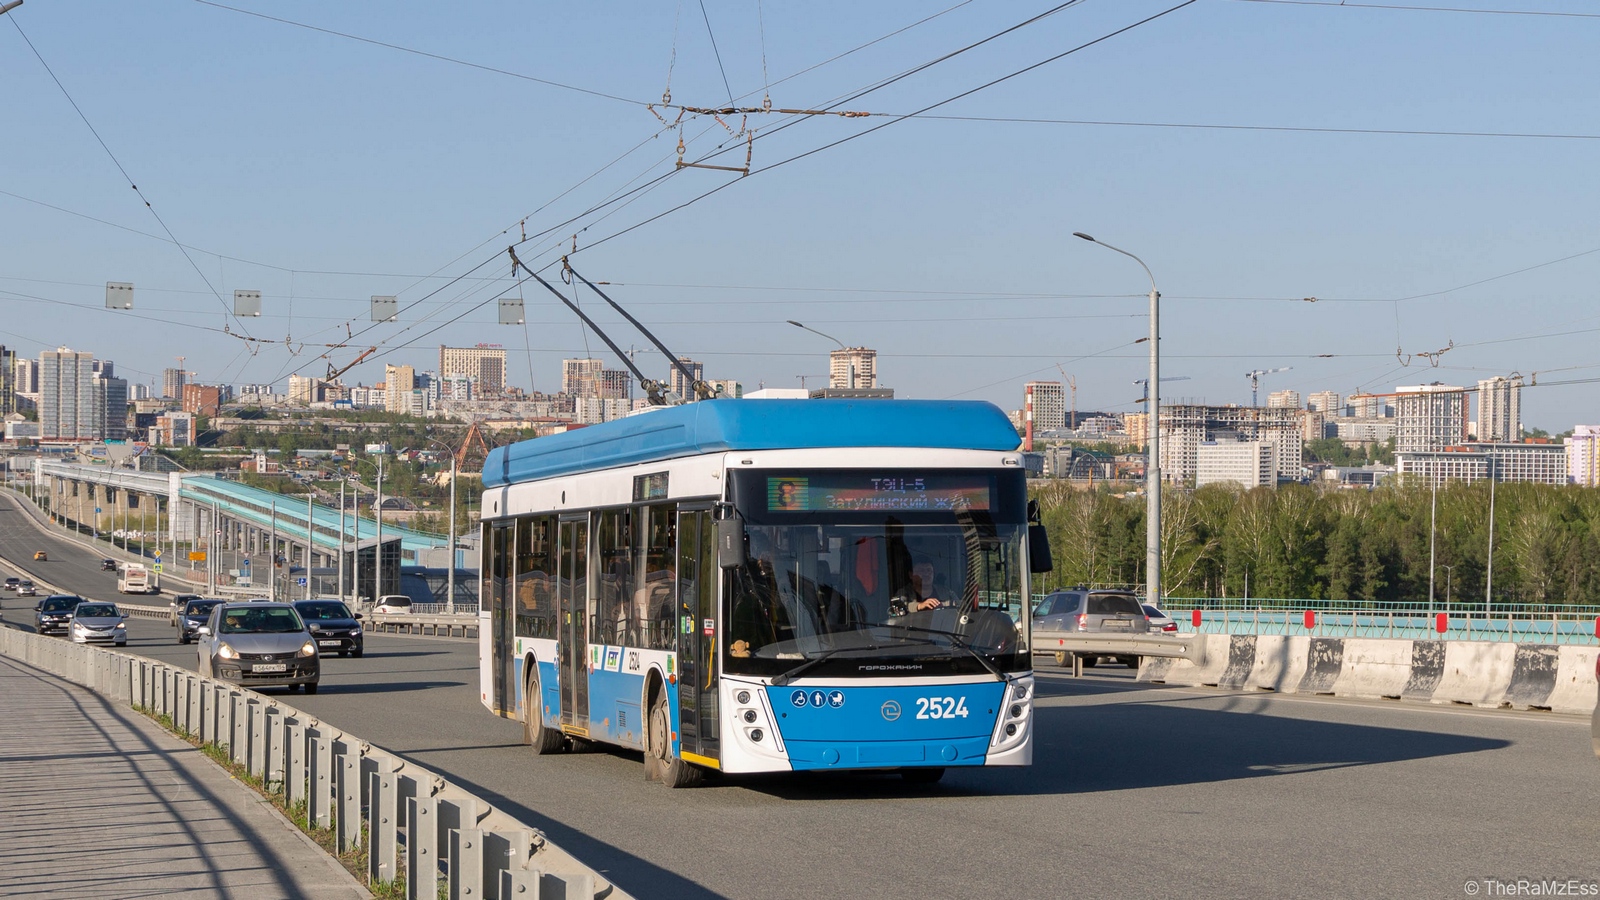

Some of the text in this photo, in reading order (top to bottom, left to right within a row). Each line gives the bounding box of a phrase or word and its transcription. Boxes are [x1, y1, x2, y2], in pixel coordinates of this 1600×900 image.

[871, 478, 925, 494] ТЭЦ-5
[825, 493, 928, 510] Затулинский
[629, 651, 640, 671] 2524
[916, 696, 969, 719] 2524
